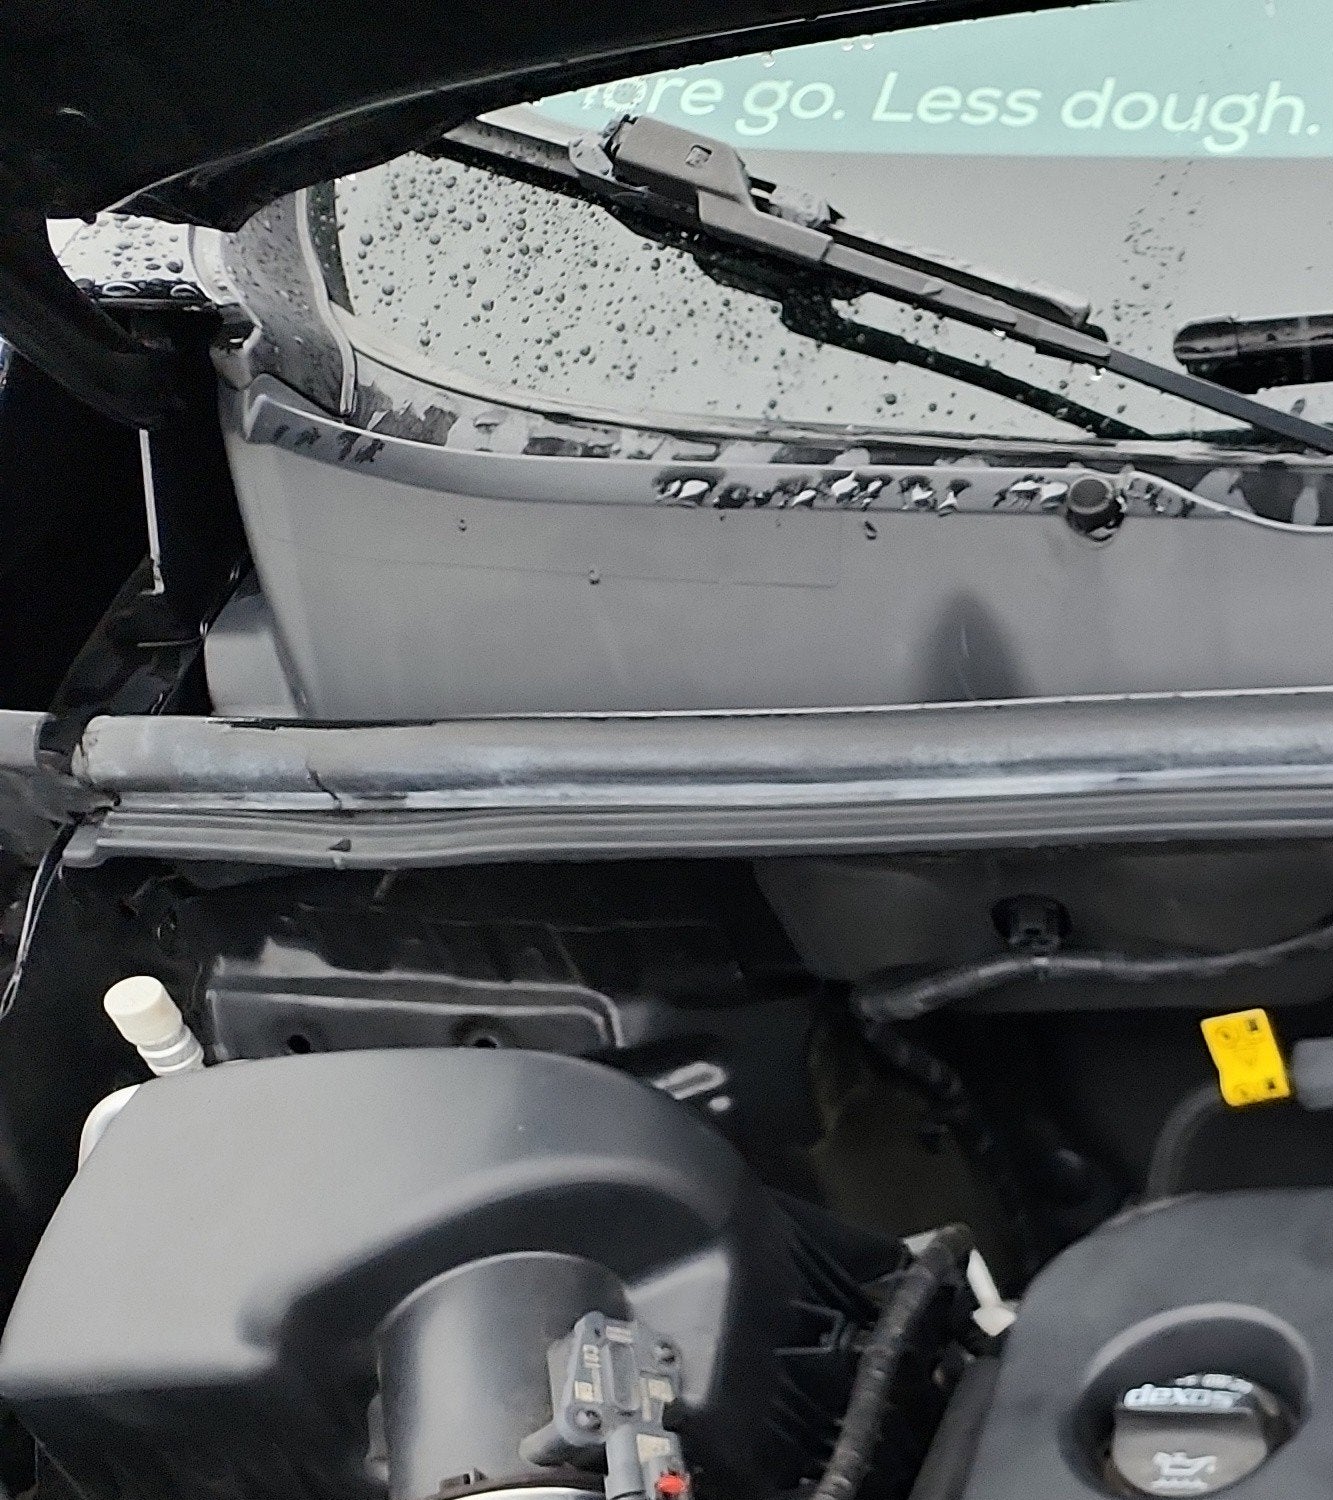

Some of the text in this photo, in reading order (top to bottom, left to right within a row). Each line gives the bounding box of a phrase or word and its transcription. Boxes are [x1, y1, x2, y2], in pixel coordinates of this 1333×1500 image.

[734, 77, 846, 137] go.
[871, 71, 1042, 127] Less
[1061, 76, 1321, 153] dough.
